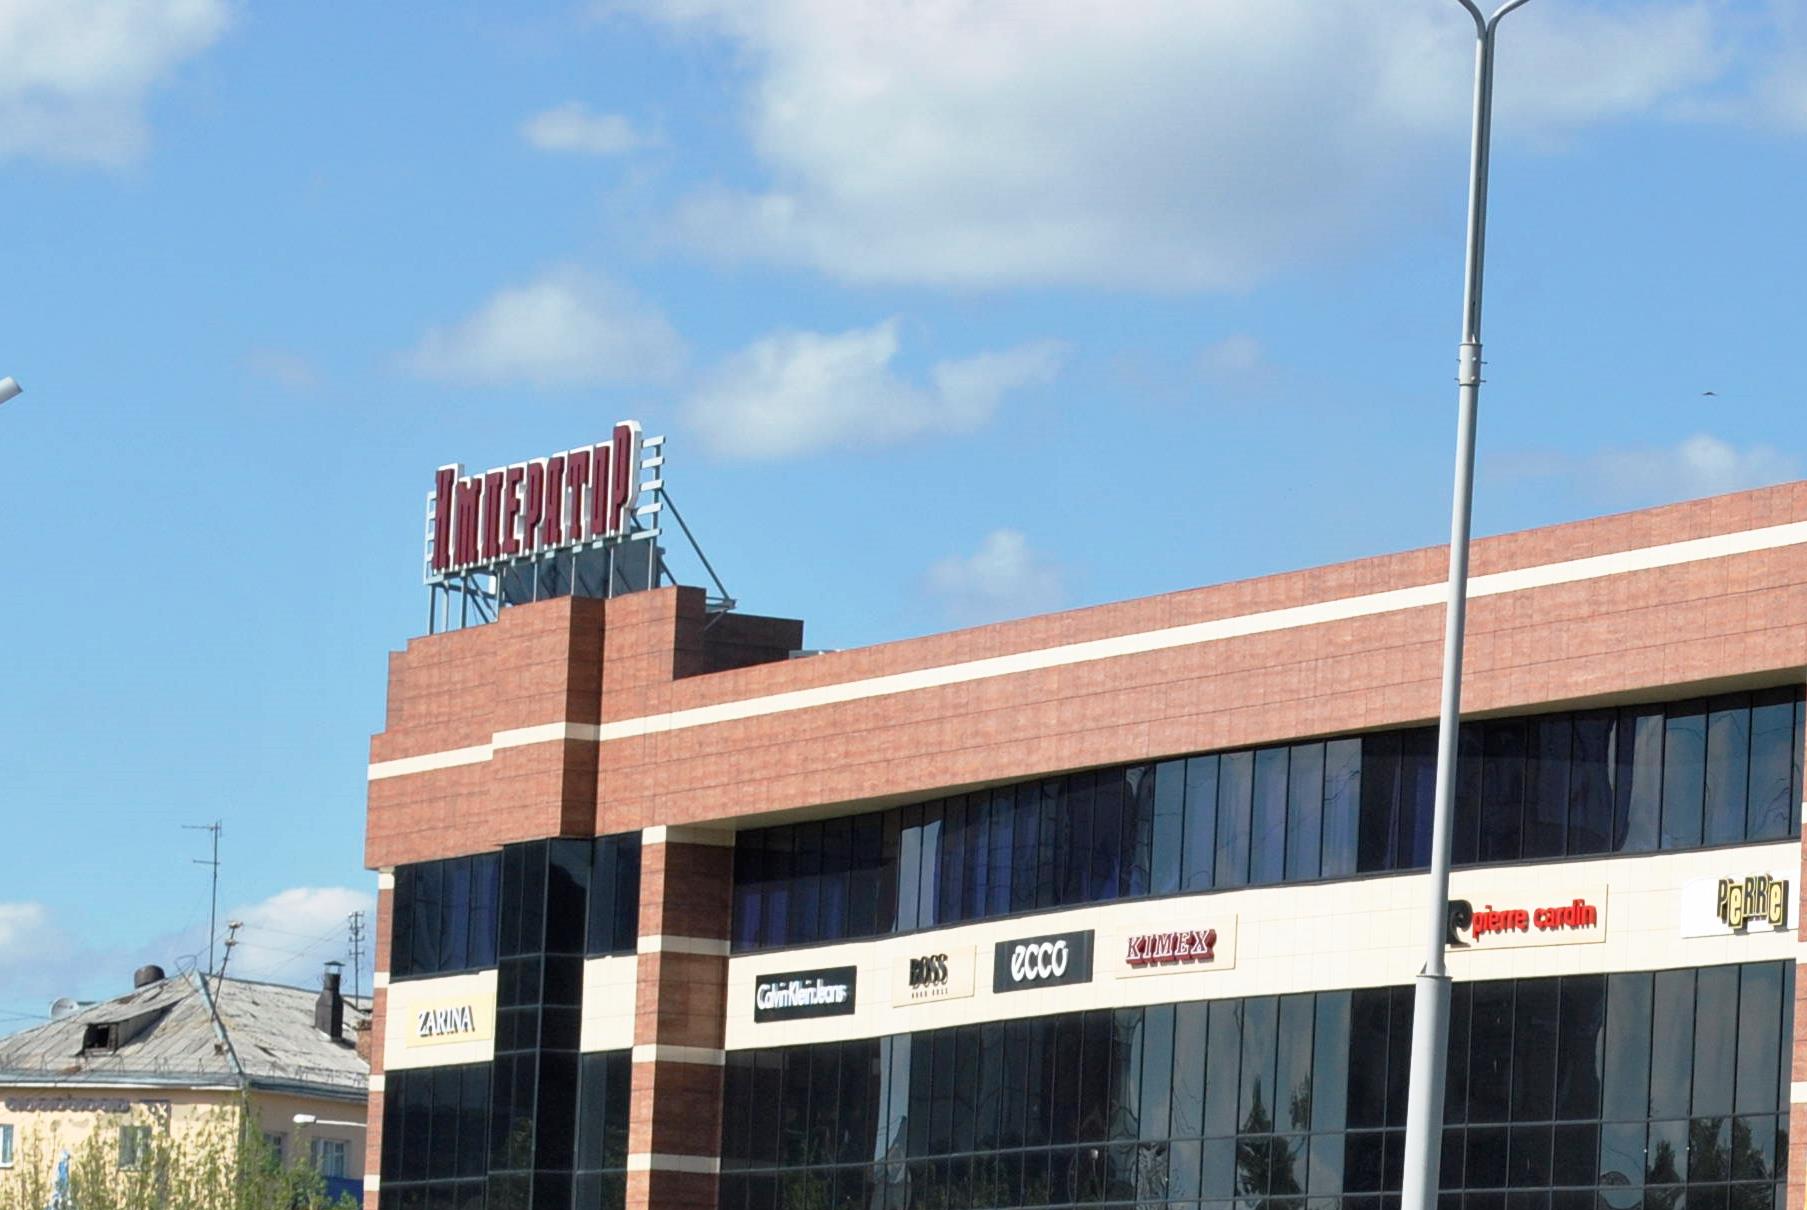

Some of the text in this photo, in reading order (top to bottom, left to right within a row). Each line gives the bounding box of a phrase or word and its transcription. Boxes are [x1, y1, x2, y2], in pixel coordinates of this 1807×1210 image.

[1473, 905, 1528, 940] pierre
[1534, 898, 1597, 930] cardin
[1011, 940, 1068, 982] ecco
[1126, 929, 1216, 966] KIMEX
[909, 953, 948, 987] BOSS
[417, 1005, 476, 1037] ZARINA
